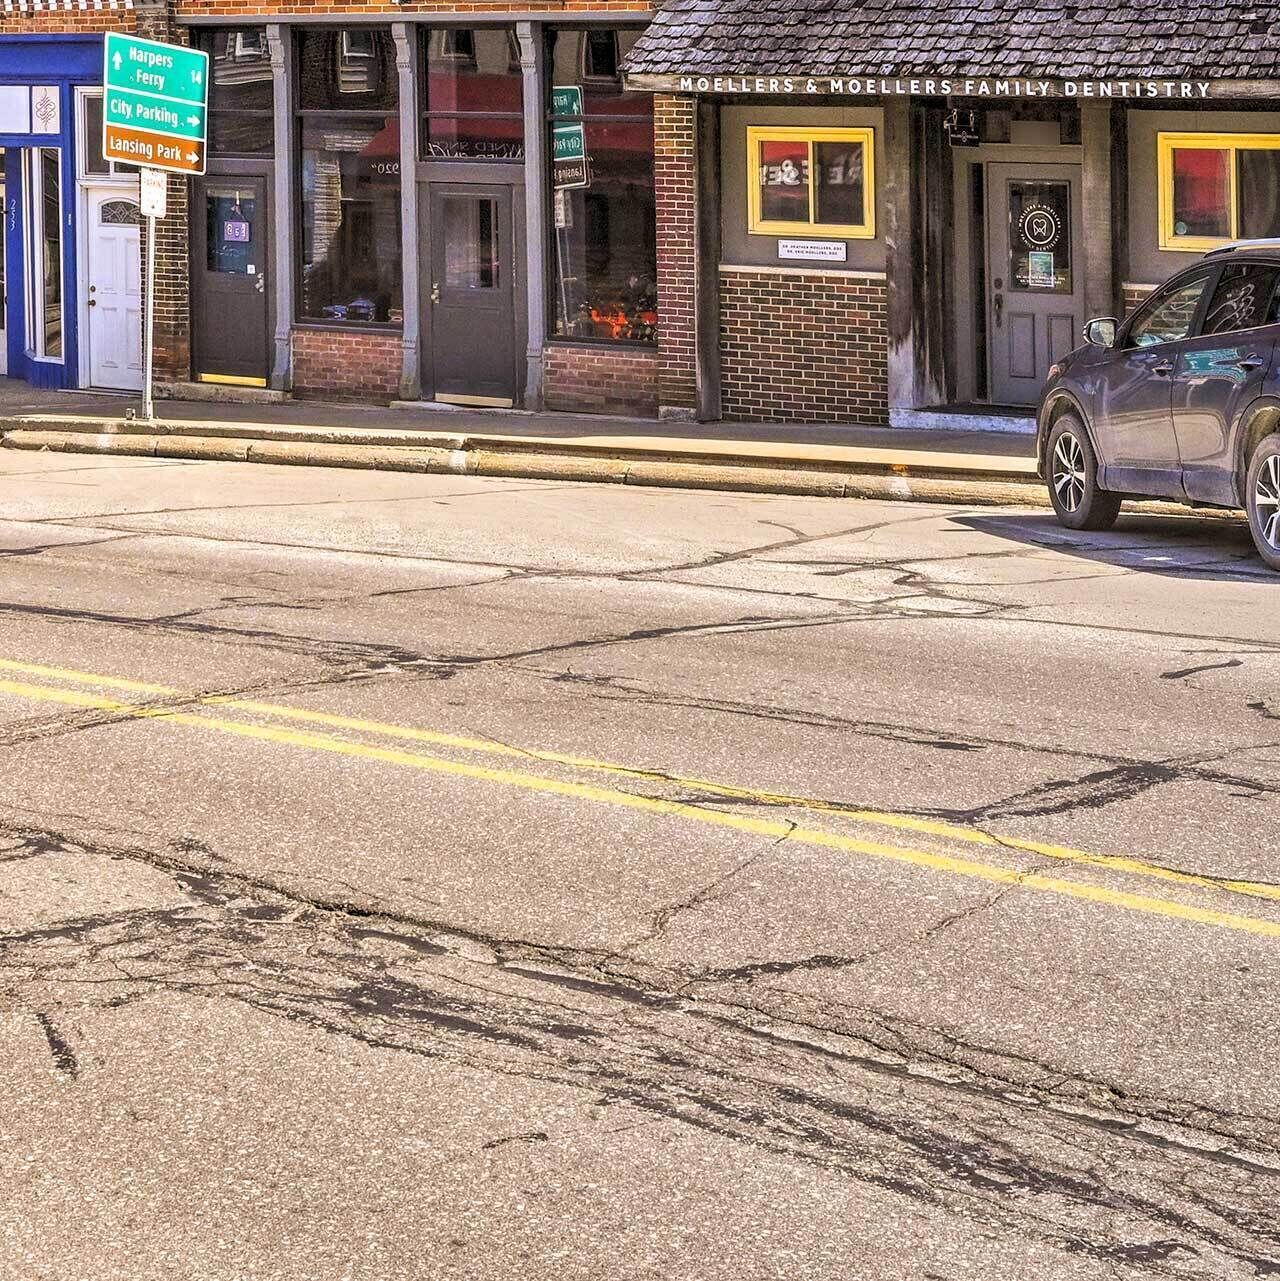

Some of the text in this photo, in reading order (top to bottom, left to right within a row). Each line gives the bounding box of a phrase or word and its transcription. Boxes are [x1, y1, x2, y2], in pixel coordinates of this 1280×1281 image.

[129, 46, 173, 68] Harpers
[136, 69, 202, 91] Ferry 14
[678, 77, 1211, 99] MOELLERS & MOELLERS FAMILY DENTISTRY
[111, 98, 179, 128] City Parking
[109, 135, 182, 161] Lansing Park
